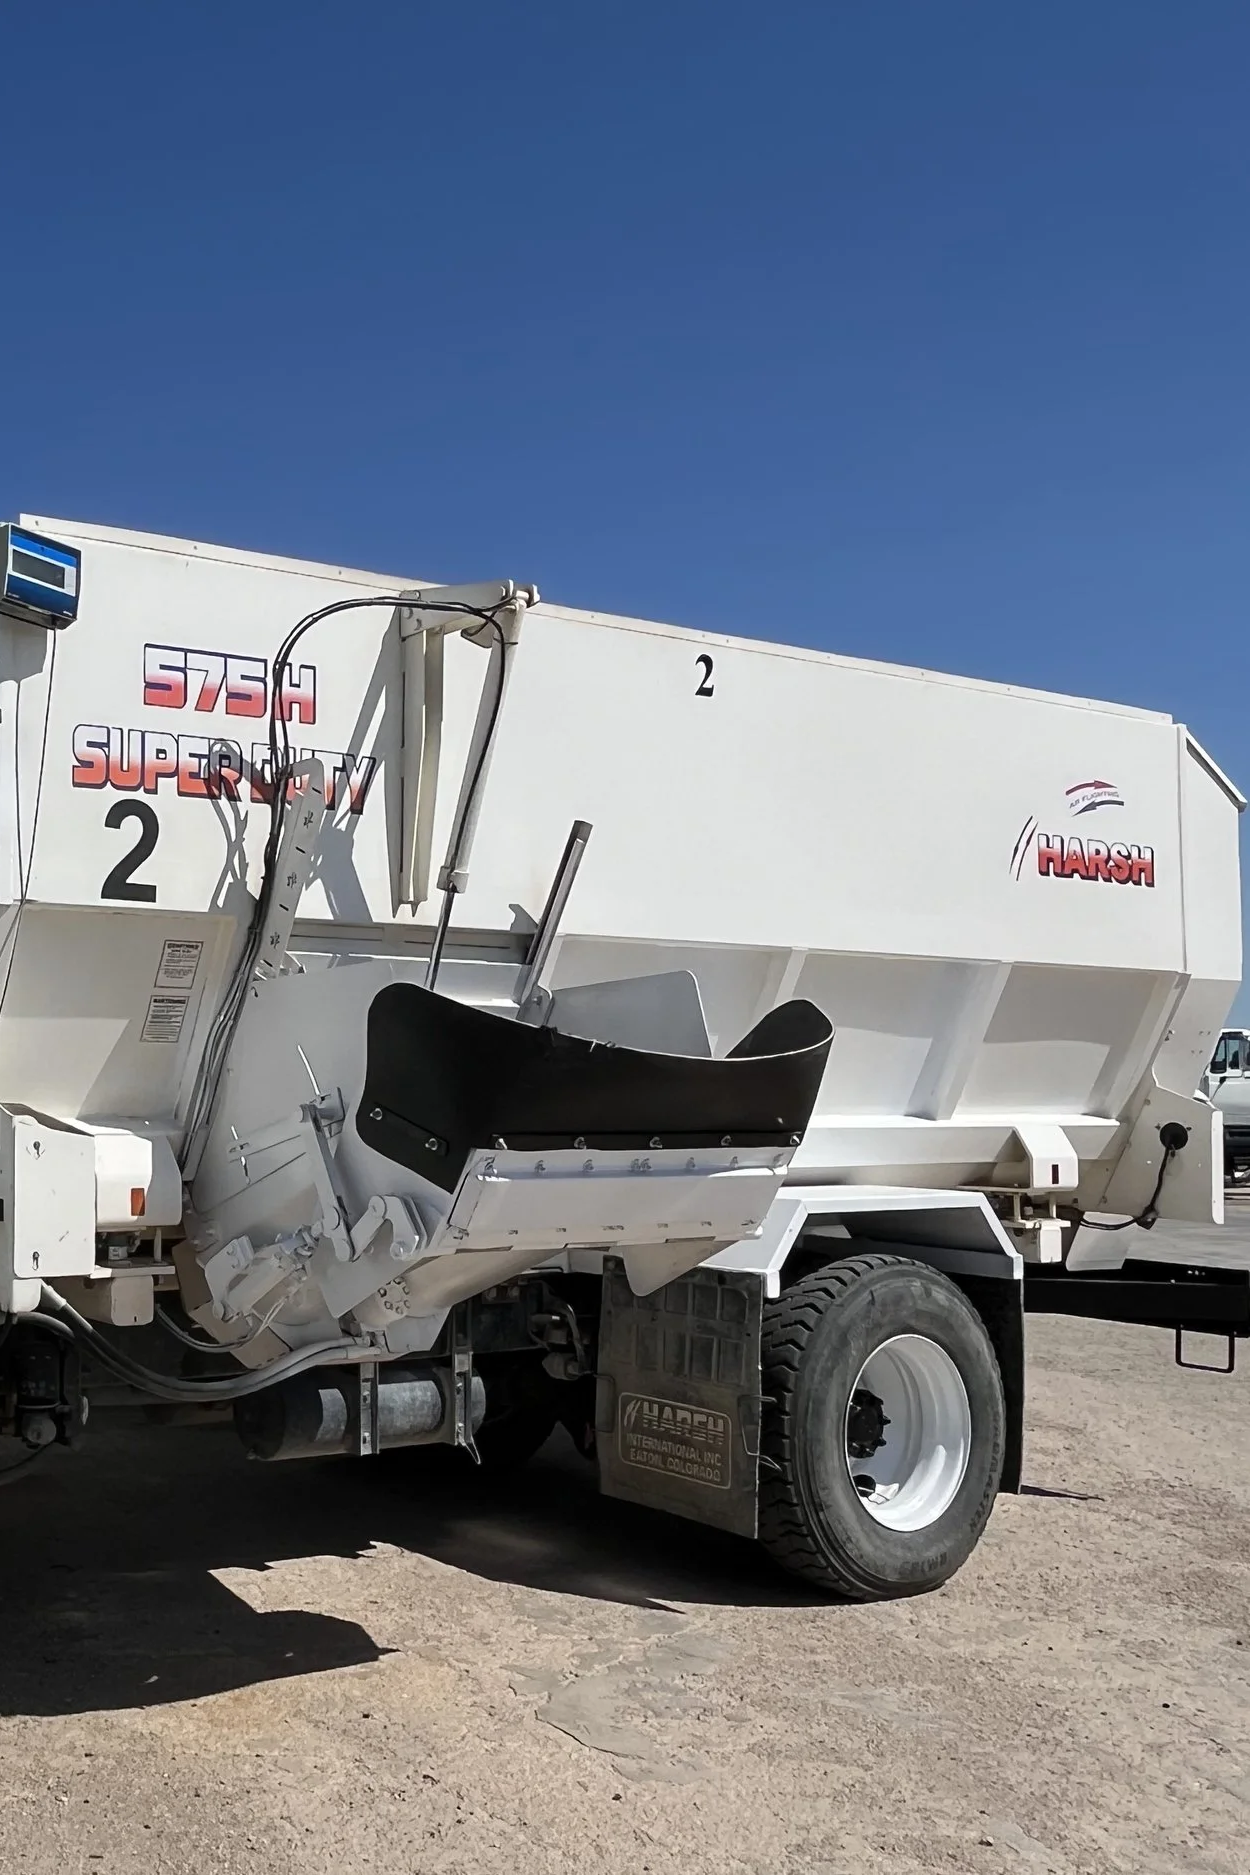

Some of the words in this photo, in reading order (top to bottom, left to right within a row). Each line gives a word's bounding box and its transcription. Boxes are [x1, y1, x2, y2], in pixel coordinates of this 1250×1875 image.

[694, 653, 715, 698] 2
[72, 723, 243, 802] SUPER
[100, 798, 160, 903] 2
[1037, 832, 1156, 889] HARSH
[642, 1400, 726, 1446] HARSH
[626, 1432, 702, 1464] INTERNATIONAL
[666, 1456, 722, 1483] COLORADO
